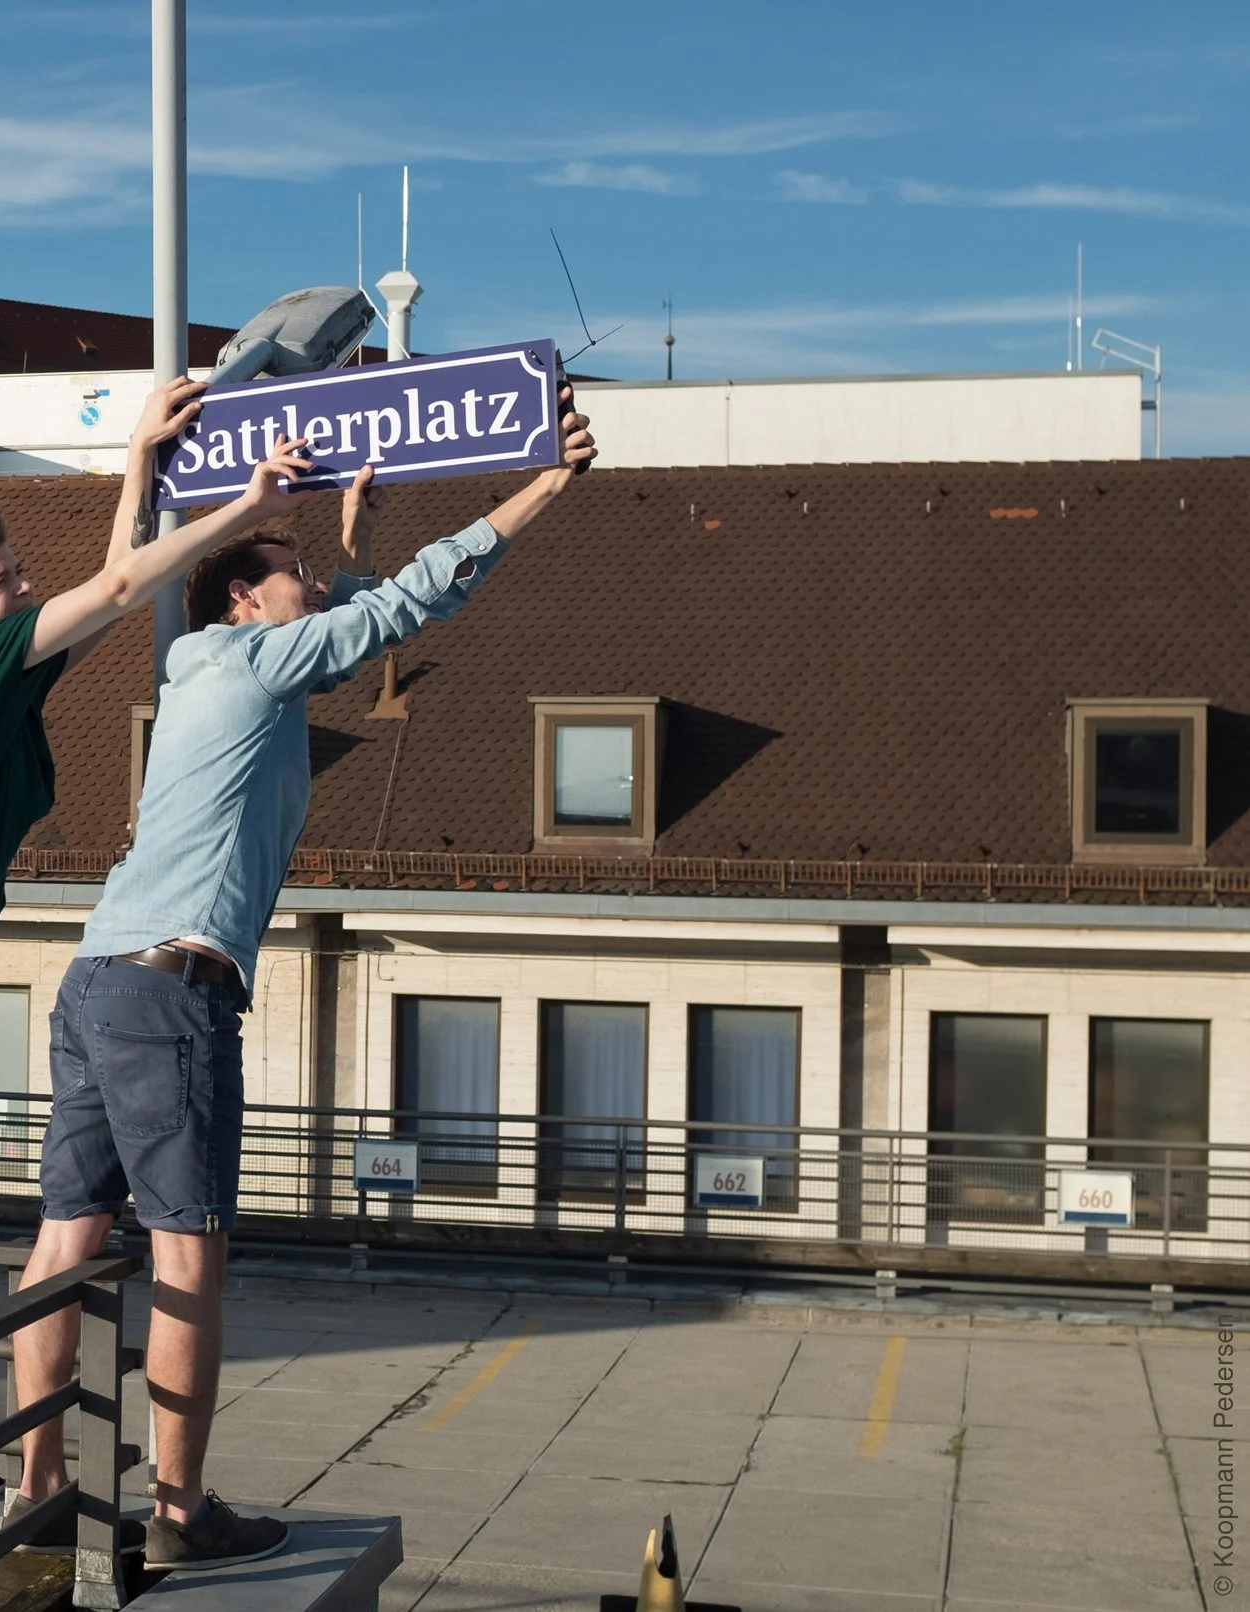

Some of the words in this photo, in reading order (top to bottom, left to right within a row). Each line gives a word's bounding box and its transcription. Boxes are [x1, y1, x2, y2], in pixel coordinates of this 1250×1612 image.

[177, 387, 522, 475] Sattlerplatz
[371, 1157, 402, 1177] 664
[713, 1172, 746, 1192] 662
[1079, 1189, 1113, 1209] 660
